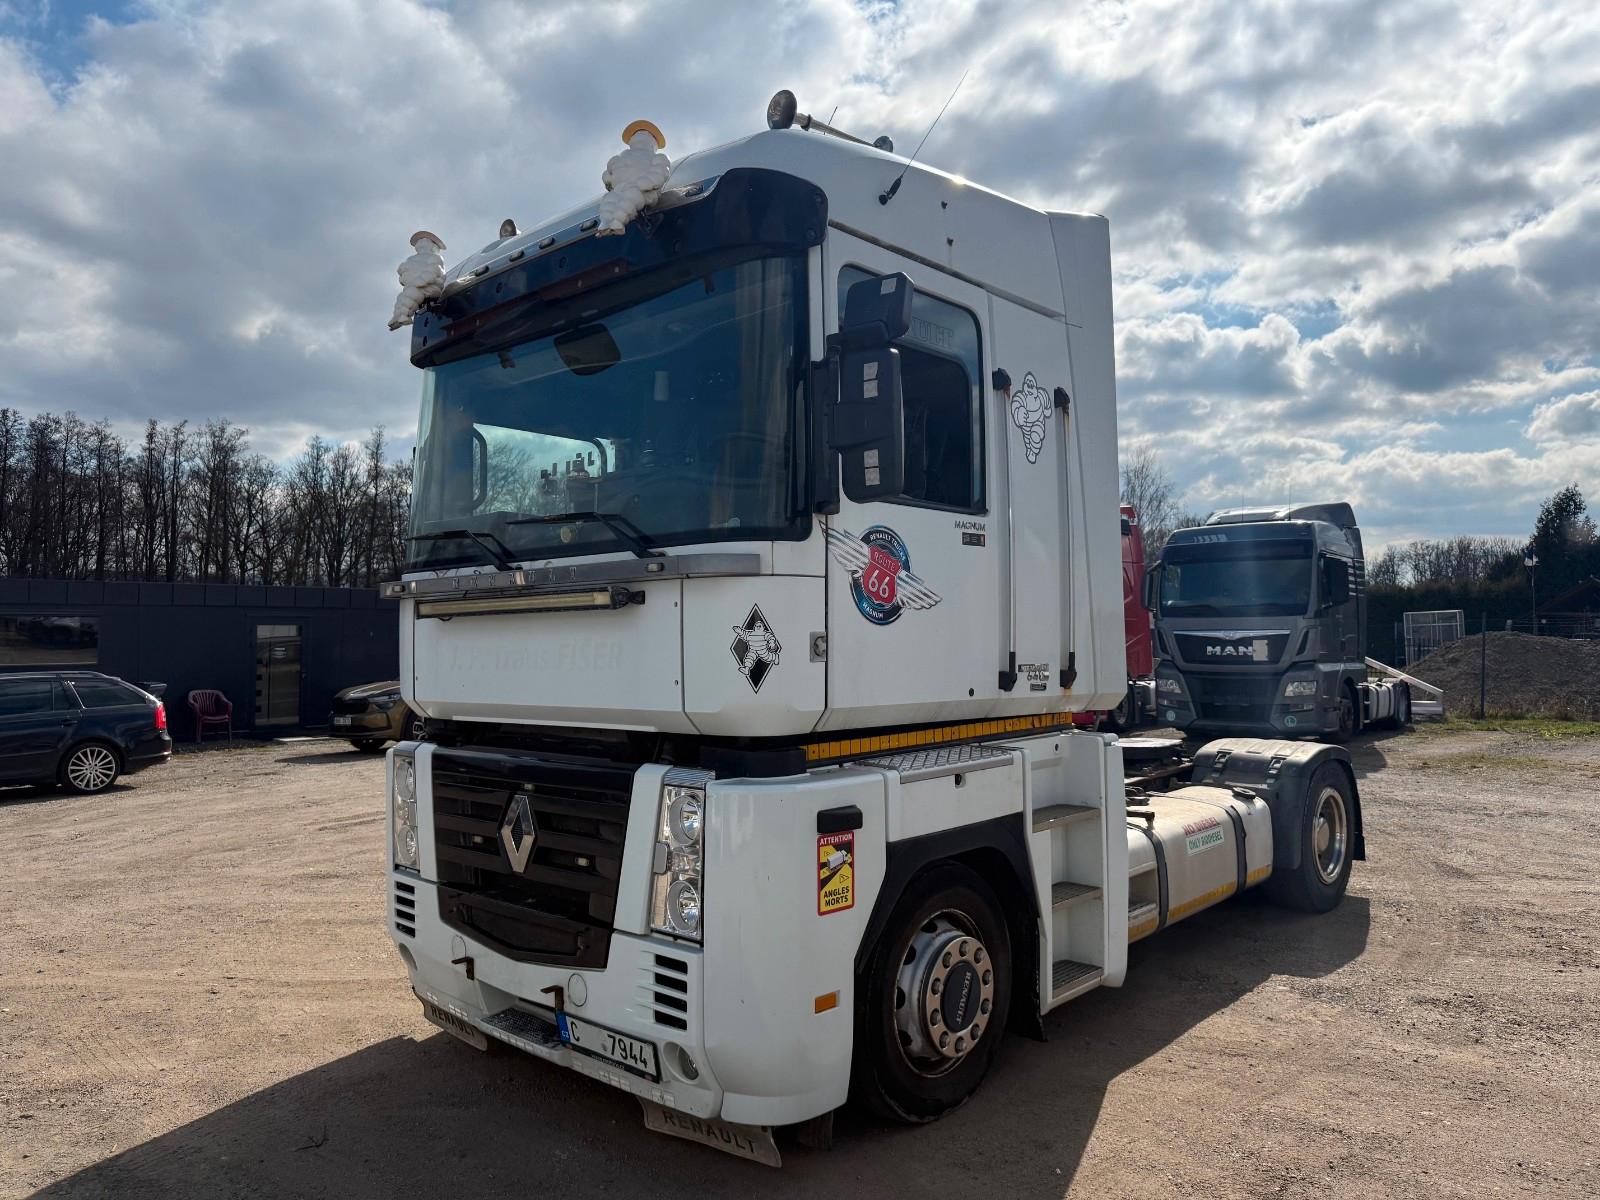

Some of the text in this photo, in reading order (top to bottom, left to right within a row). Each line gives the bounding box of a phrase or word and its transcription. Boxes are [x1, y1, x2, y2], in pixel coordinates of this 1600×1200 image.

[954, 520, 986, 531] MAGNUM
[869, 532, 892, 541] RENAULT
[874, 551, 896, 571] ROUTE
[868, 569, 890, 599] 66
[1206, 646, 1253, 656] MAN
[819, 833, 853, 846] ATTENTION
[823, 886, 850, 900] ANGLES
[824, 894, 849, 907] MORTS
[956, 971, 972, 1025] RENAULT
[430, 1004, 476, 1038] RENAULT
[561, 1030, 570, 1039] CZ
[607, 1033, 649, 1069] 7944
[662, 1109, 757, 1154] RENAULT
